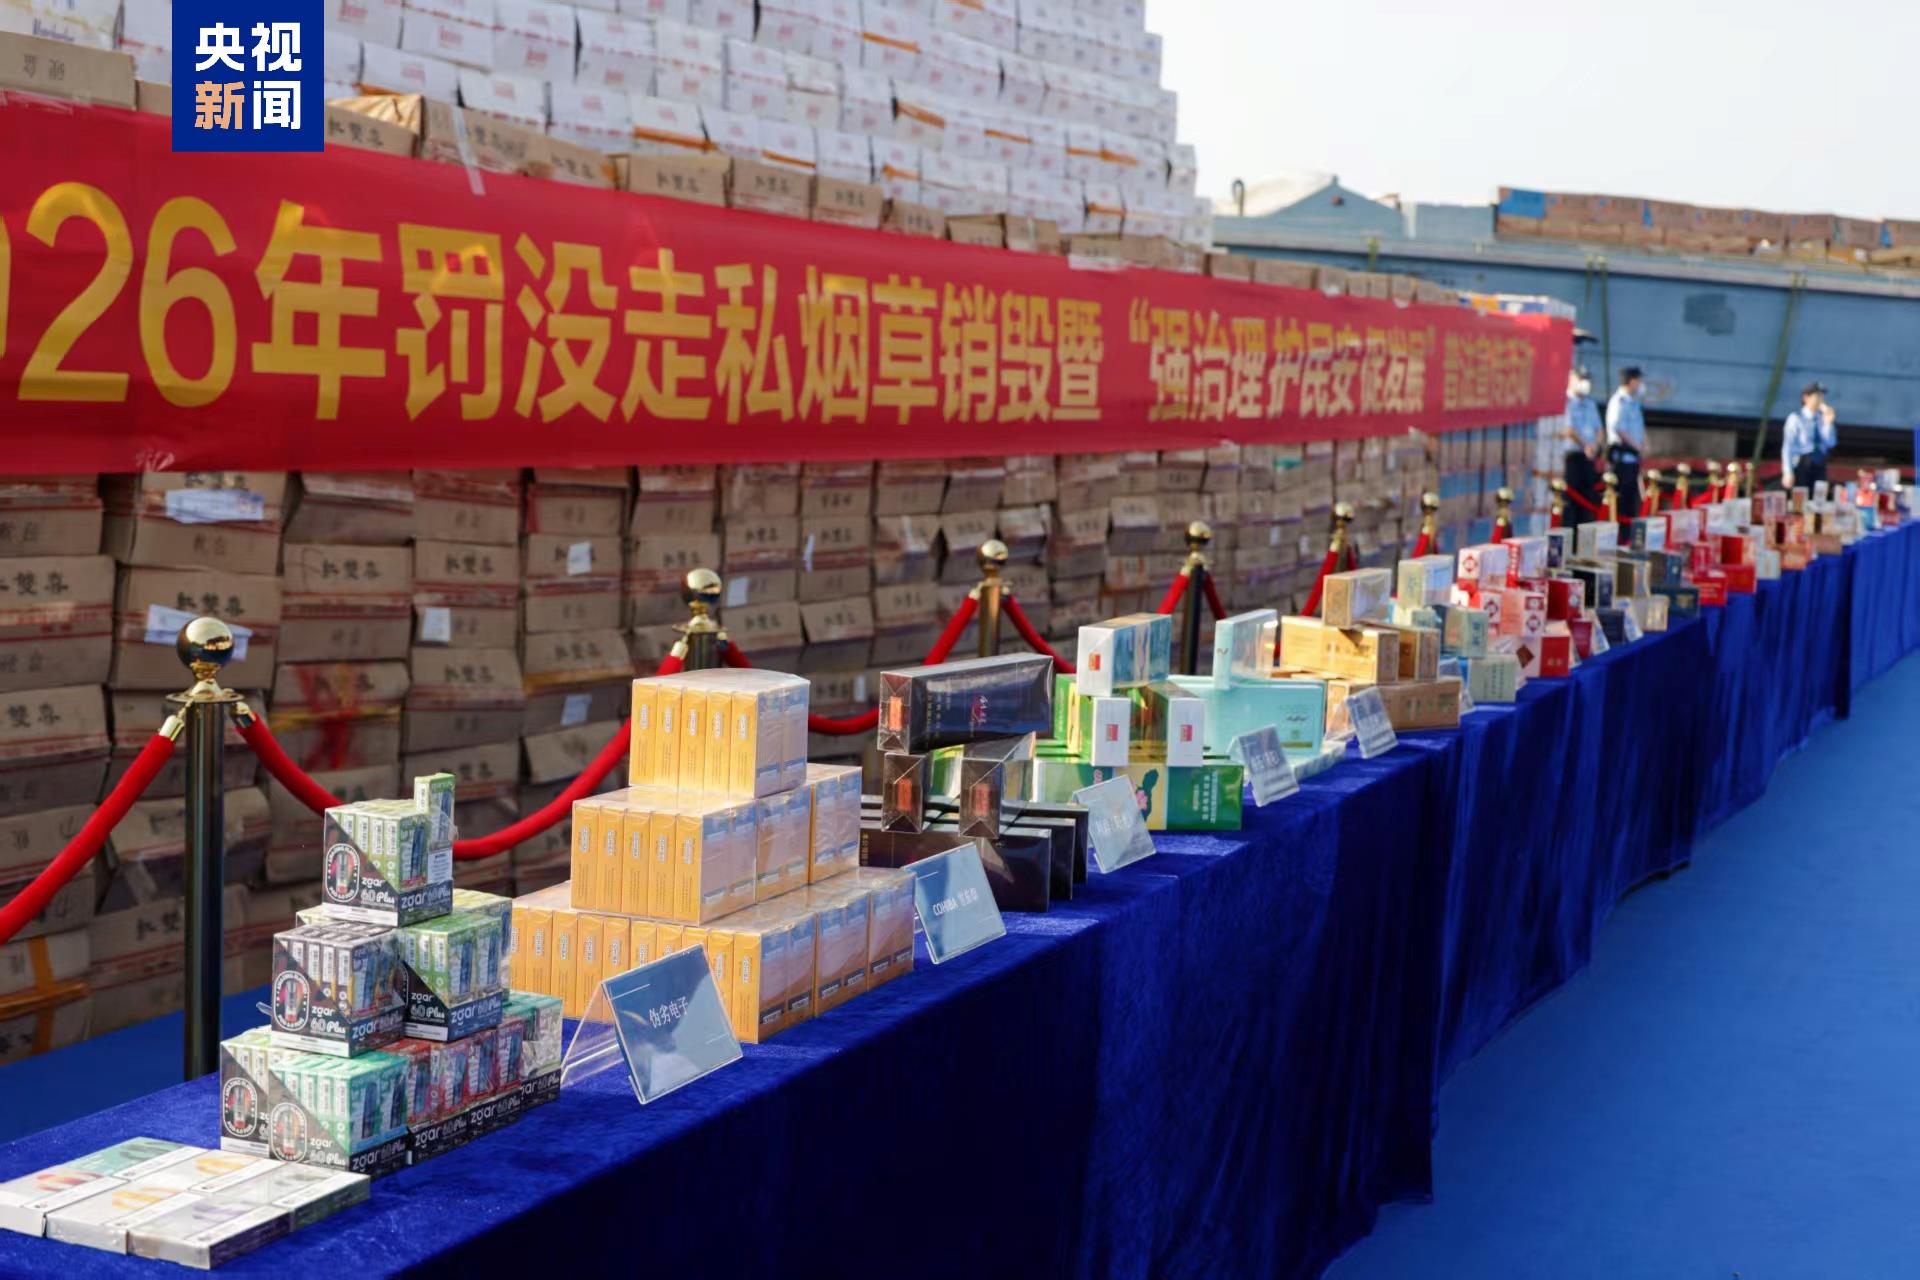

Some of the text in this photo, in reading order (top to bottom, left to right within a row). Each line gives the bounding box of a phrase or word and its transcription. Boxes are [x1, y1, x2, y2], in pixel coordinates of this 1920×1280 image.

[0, 181, 1104, 424] 26年罚没走私烟草销毁暨
[361, 877, 386, 889] zgar
[401, 891, 427, 912] zgar
[411, 993, 433, 1004] zgar
[311, 1006, 336, 1017] zgar
[451, 1006, 477, 1025] zgar
[352, 1020, 377, 1041] zgar
[470, 1104, 497, 1126] zgar
[310, 1137, 334, 1150] zgar
[415, 1127, 440, 1149] zgar
[352, 1150, 379, 1172] zgar
